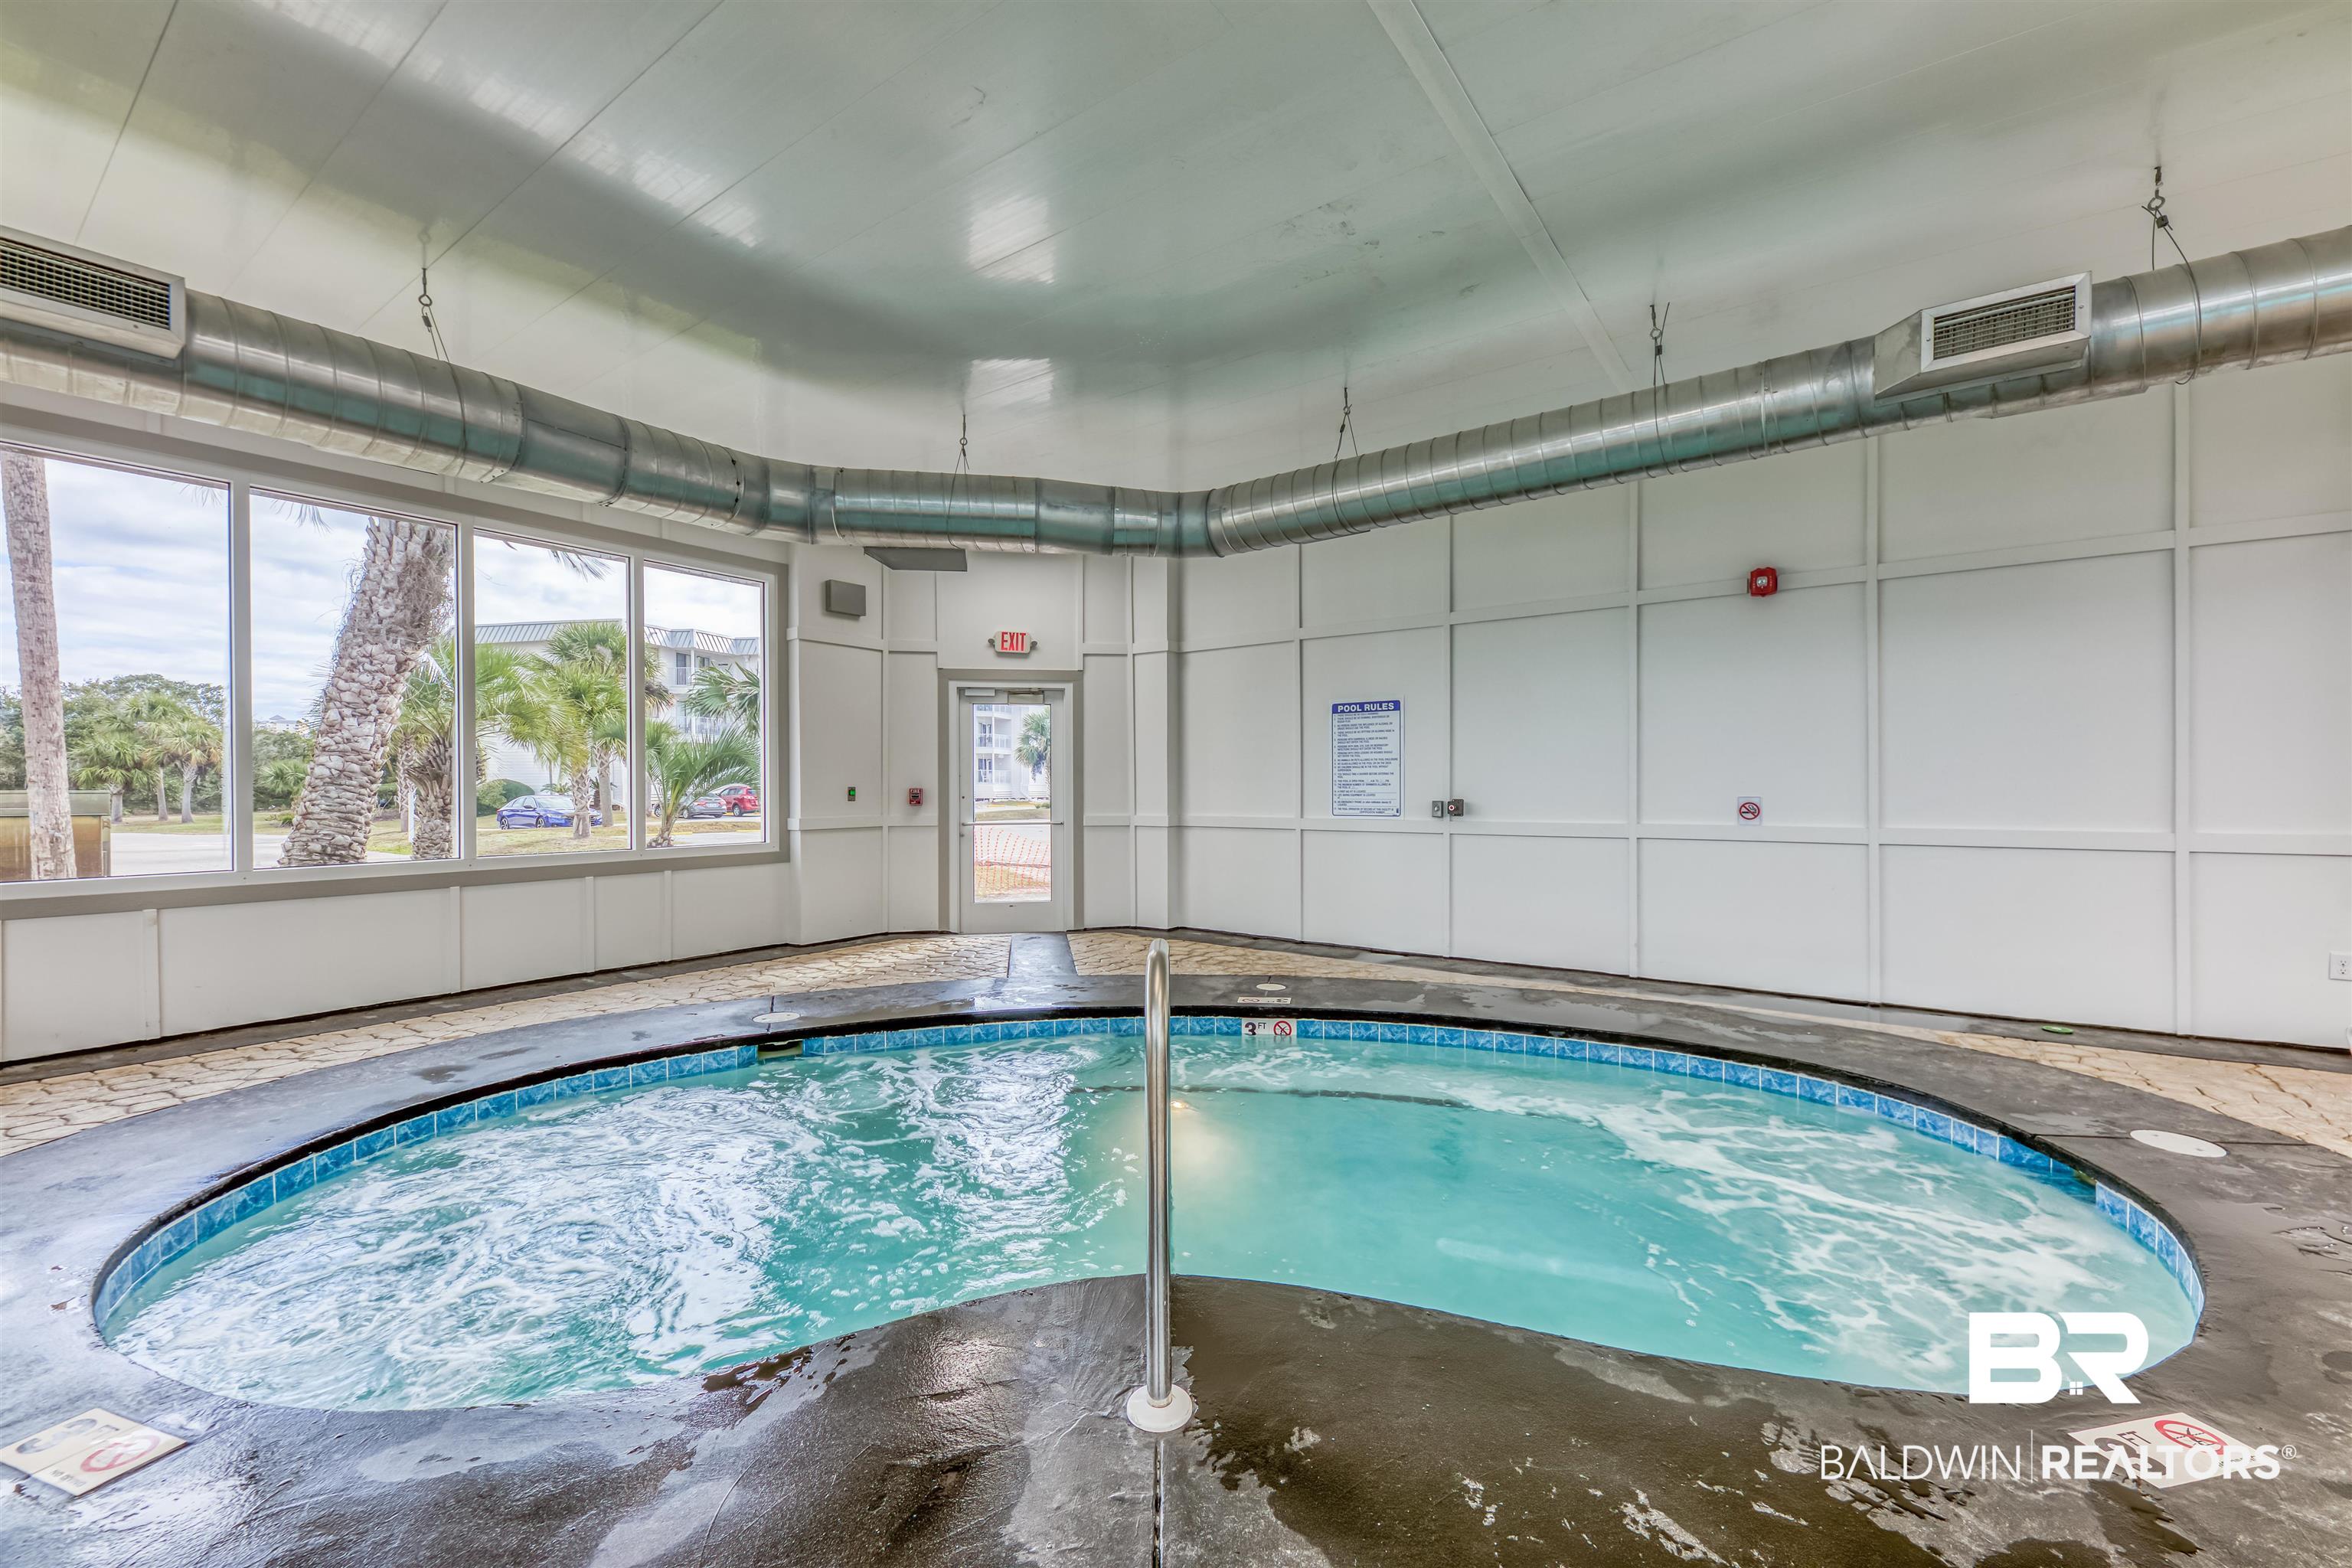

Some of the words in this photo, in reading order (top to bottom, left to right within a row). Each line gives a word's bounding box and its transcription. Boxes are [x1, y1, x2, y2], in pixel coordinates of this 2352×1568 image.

[1001, 631, 1027, 652] EXIT
[1338, 704, 1362, 713] POOL
[1364, 702, 1395, 710] RULES
[1244, 1021, 1257, 1036] 3
[2116, 1430, 2151, 1447] FT
